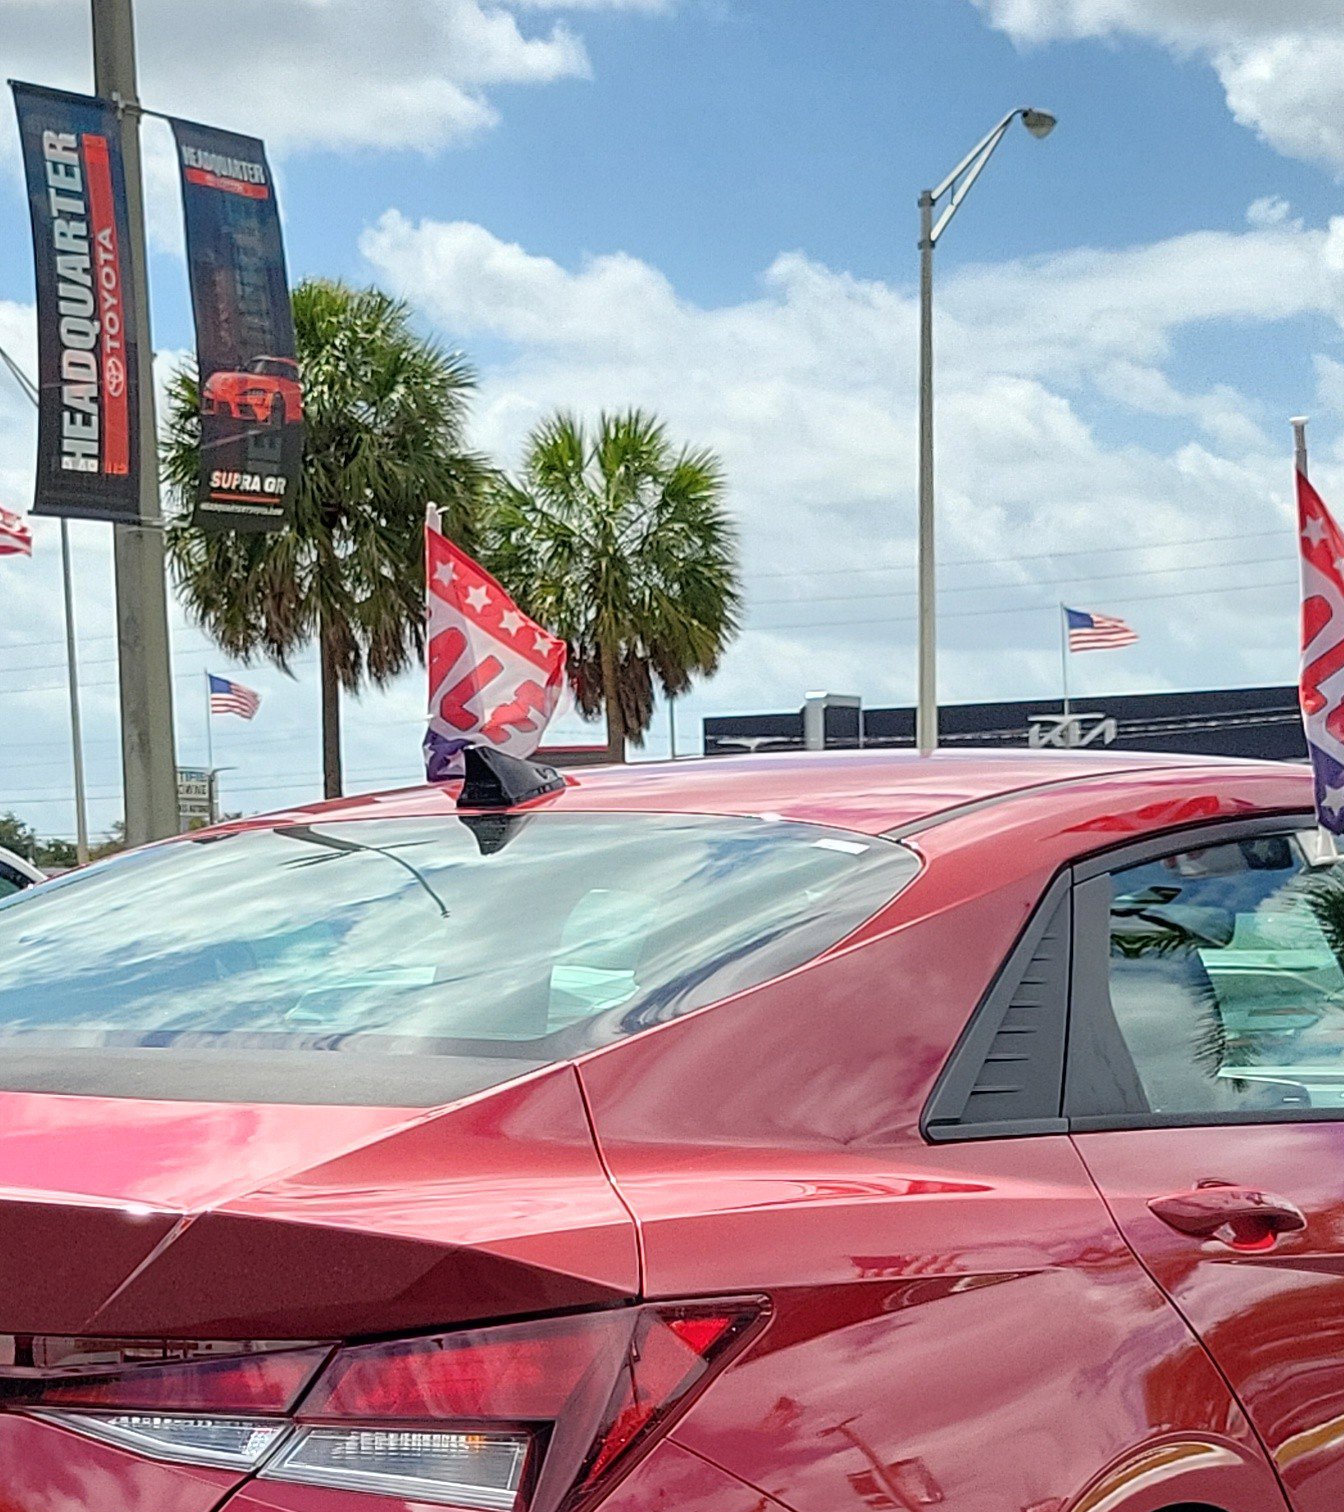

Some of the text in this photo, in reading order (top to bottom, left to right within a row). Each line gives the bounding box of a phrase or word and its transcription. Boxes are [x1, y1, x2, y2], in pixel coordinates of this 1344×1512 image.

[43, 129, 101, 474] HEADQUARTER
[94, 226, 120, 354] TOYOTA
[209, 470, 287, 494] SUPRA GR
